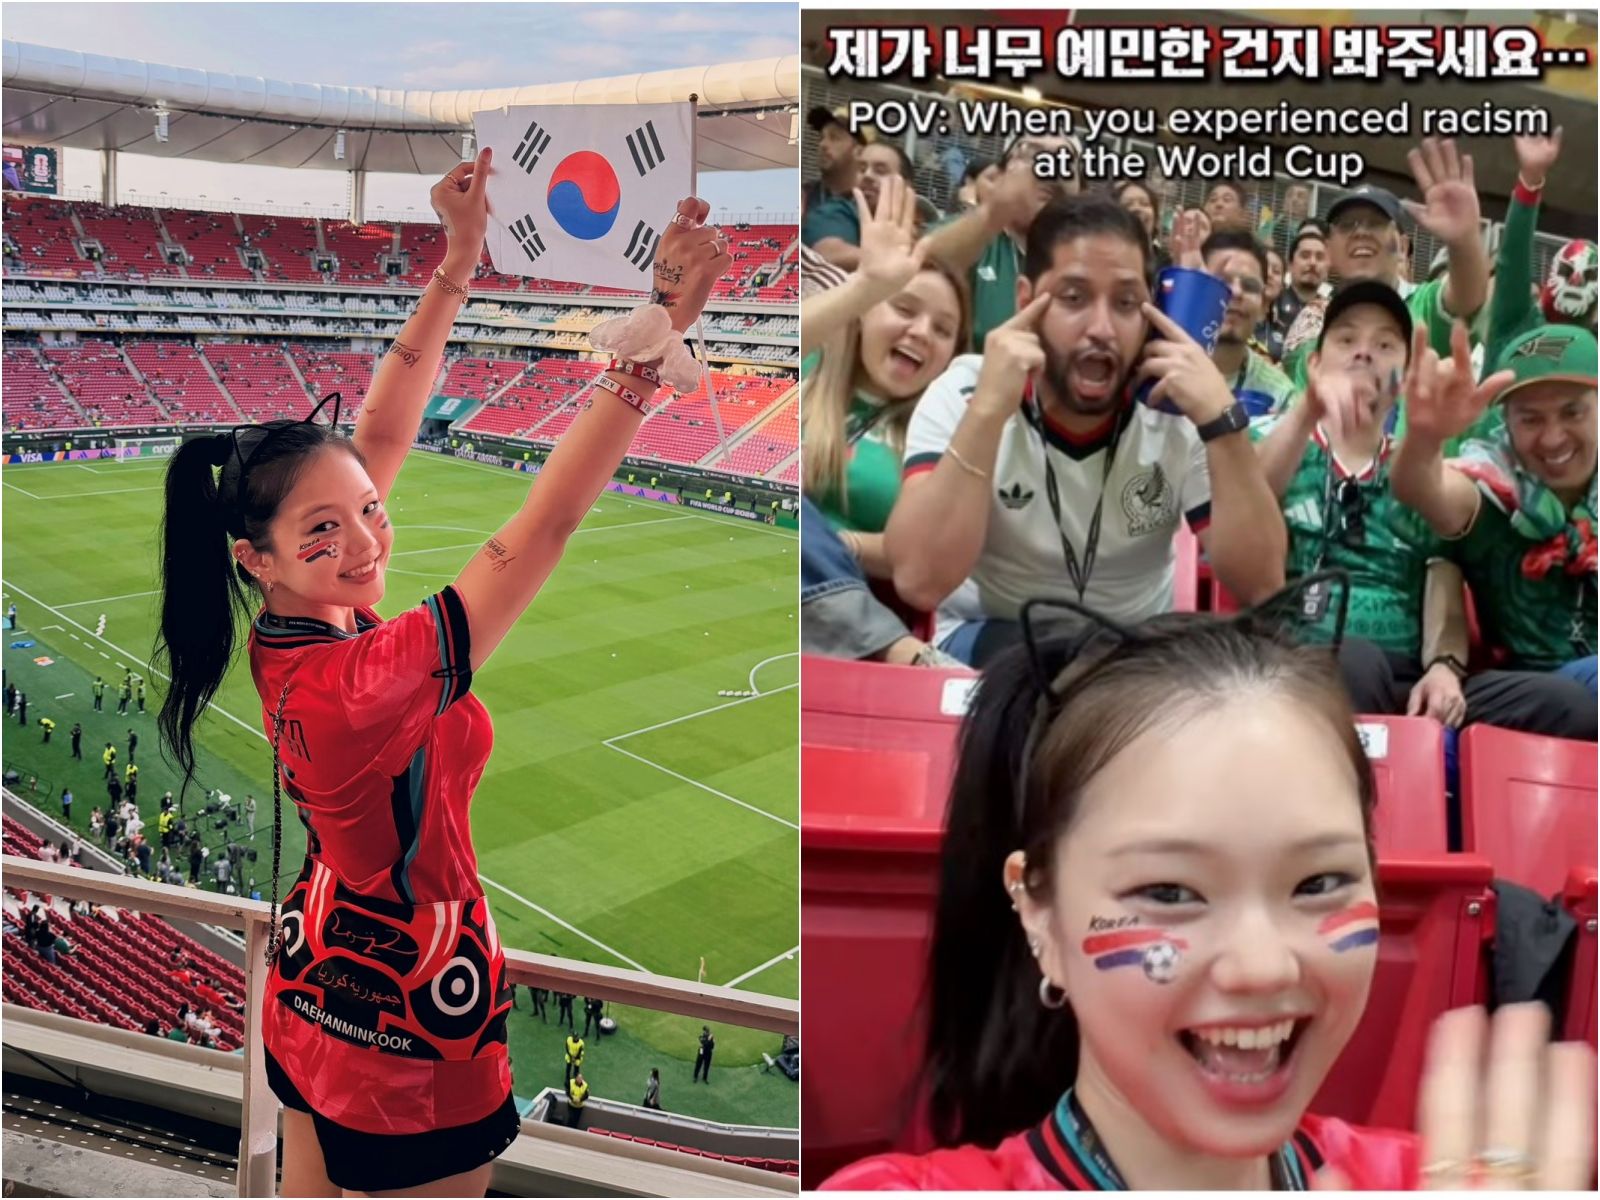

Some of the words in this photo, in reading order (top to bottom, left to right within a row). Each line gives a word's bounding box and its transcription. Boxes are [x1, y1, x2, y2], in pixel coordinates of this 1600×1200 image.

[20, 452, 43, 463] VISA
[702, 502, 722, 512] WORLD
[722, 506, 735, 514] CUP
[1088, 915, 1140, 932] KOREA
[294, 995, 413, 1051] DAEHANMINKOOK
